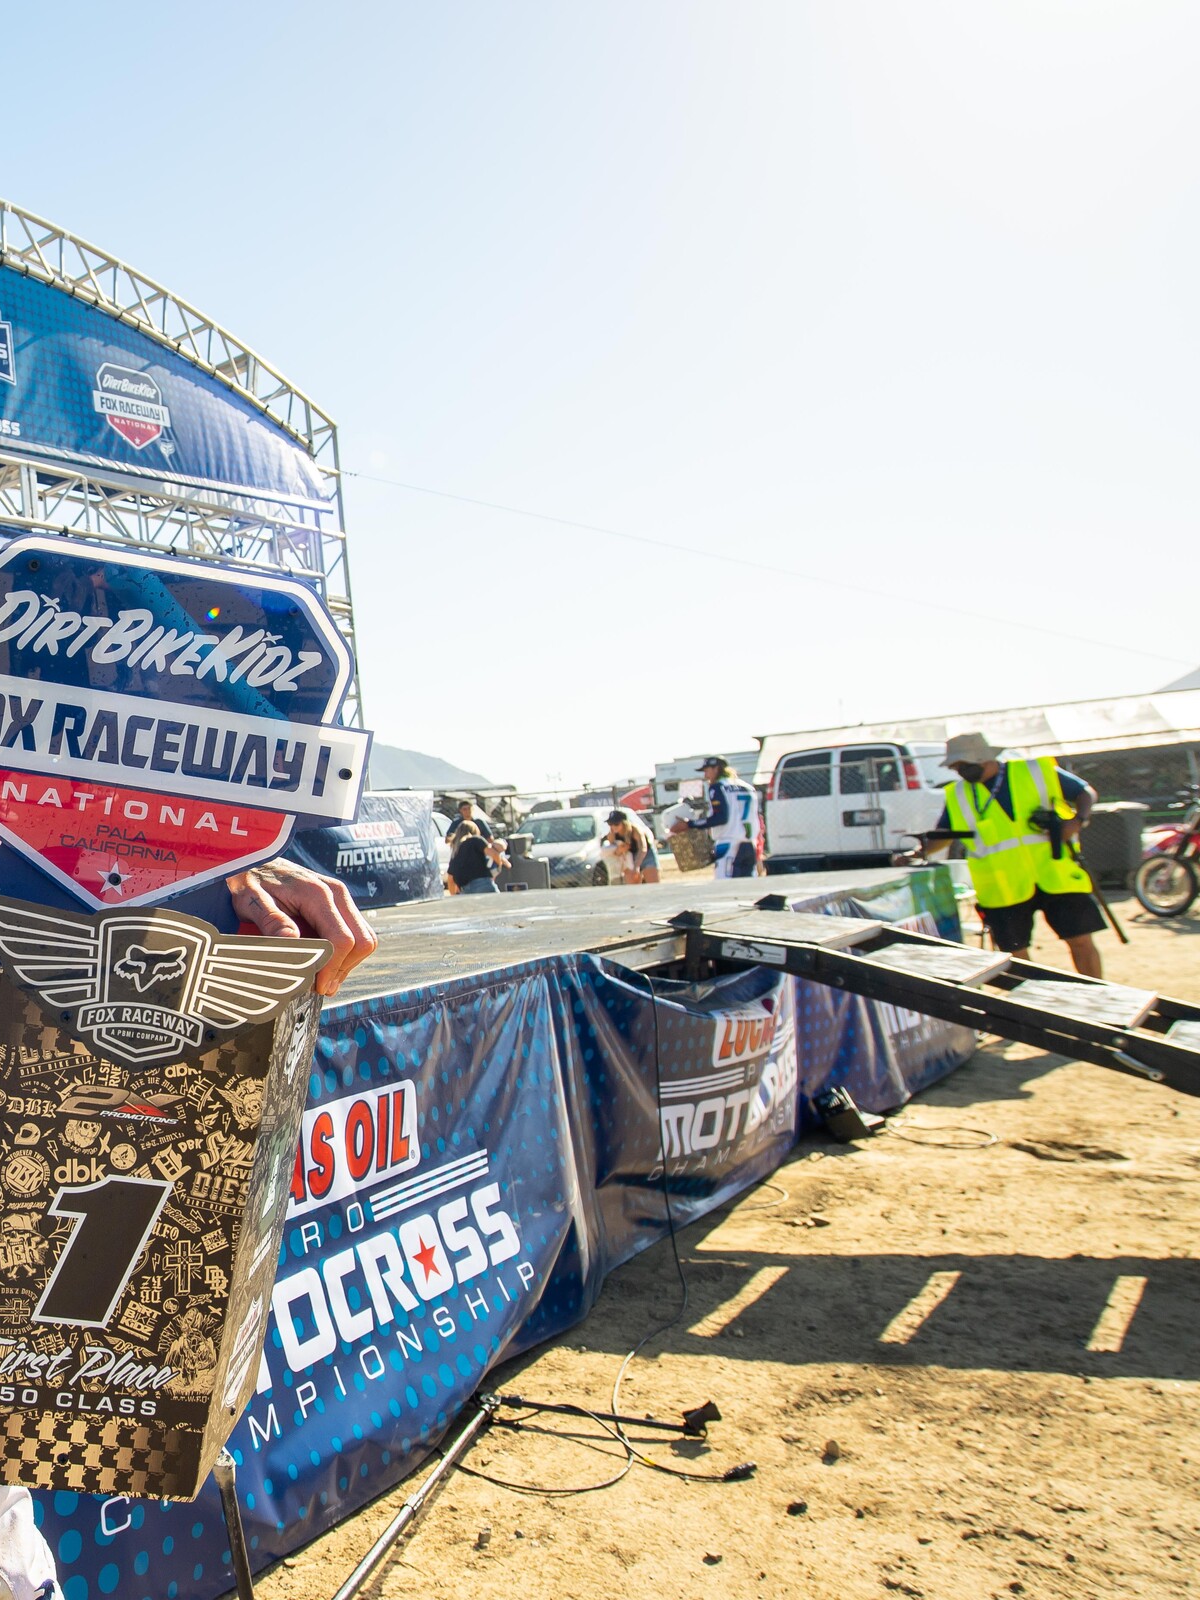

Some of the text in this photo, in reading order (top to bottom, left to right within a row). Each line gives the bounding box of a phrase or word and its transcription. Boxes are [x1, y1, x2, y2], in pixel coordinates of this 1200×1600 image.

[100, 396, 118, 411] FOX
[120, 402, 161, 421] RACEWAY
[114, 417, 156, 431] NATIONAL
[48, 703, 308, 794] RACEWAY
[1, 780, 250, 838] NATIONAL
[95, 825, 147, 843] PALA
[60, 835, 178, 864] CALIFORNIA
[336, 843, 425, 868] MOTOCROSS
[86, 1007, 195, 1037] FOX RACEWAY
[111, 1028, 168, 1042] A PBMI COMPANY
[20, 1065, 41, 1076] DIRT
[47, 1059, 69, 1070] BIKE
[20, 1080, 32, 1088] LIVE
[40, 1082, 51, 1091] RIDE
[6, 1096, 57, 1118] DBK
[100, 1110, 179, 1125] PROMOTIONS
[178, 1138, 204, 1153] DBK
[345, 1089, 411, 1182] OIL
[54, 1157, 107, 1184] dbk
[31, 1174, 176, 1330] 1
[124, 1310, 158, 1329] BIKE
[128, 1300, 161, 1320] DIRT
[69, 1345, 181, 1391] Place
[56, 1392, 157, 1416] CLASS
